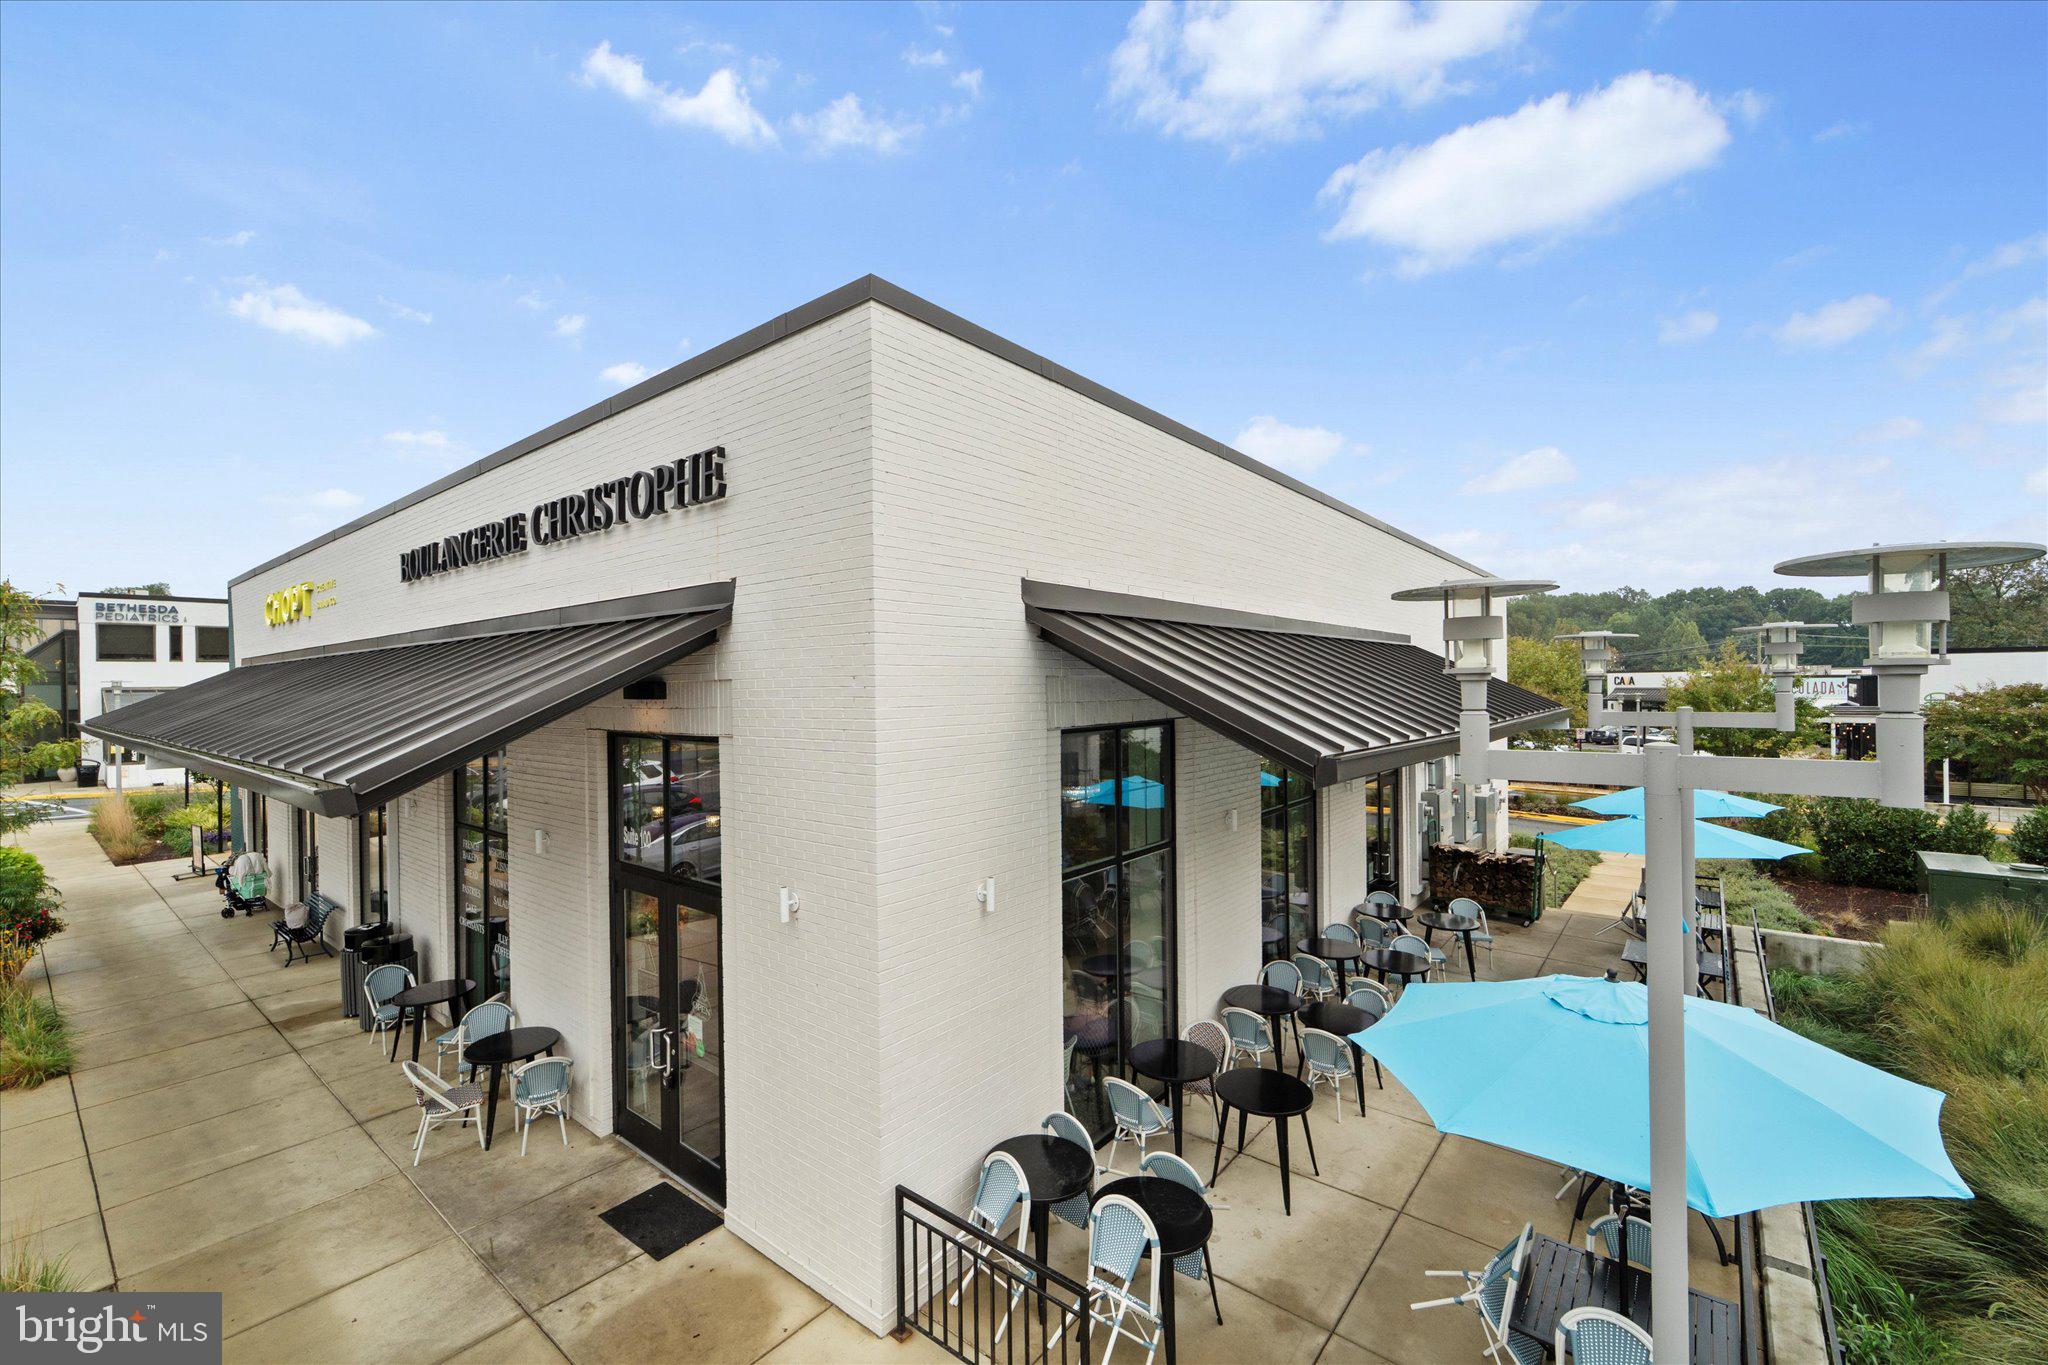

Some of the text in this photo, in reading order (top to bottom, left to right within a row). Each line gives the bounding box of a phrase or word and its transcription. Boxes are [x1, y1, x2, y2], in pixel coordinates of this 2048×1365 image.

[399, 446, 727, 582] BOULANGERIE CHRISTOPHE
[95, 602, 179, 614] BETHESDA
[264, 581, 314, 627] CHOPT
[95, 612, 179, 623] PEDIATRICS
[1793, 681, 1835, 695] OLADA
